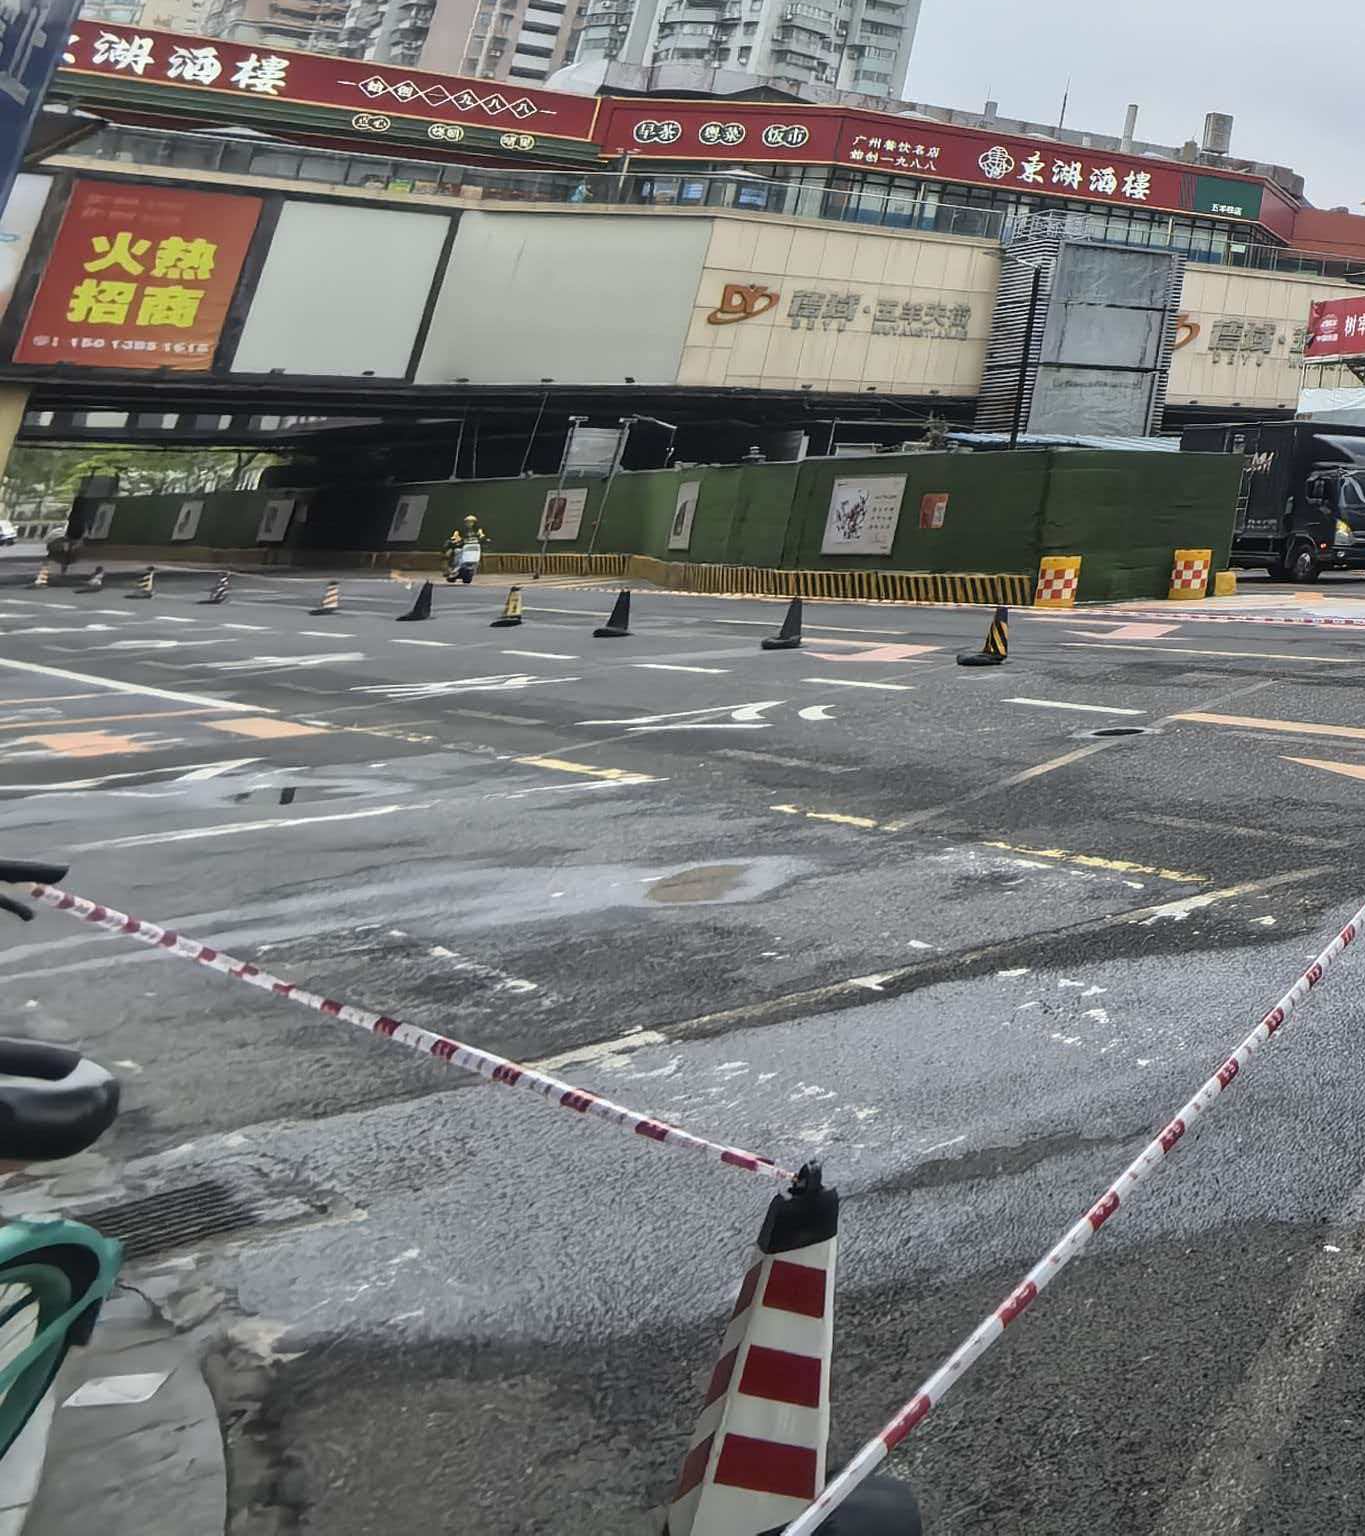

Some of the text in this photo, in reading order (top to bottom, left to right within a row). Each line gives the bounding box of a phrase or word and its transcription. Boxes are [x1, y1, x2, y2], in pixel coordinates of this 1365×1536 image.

[64, 30, 290, 96] 湖酒樓
[852, 135, 941, 158] 广州餐饮名店
[84, 232, 217, 280] 火热
[67, 278, 205, 328] 招商
